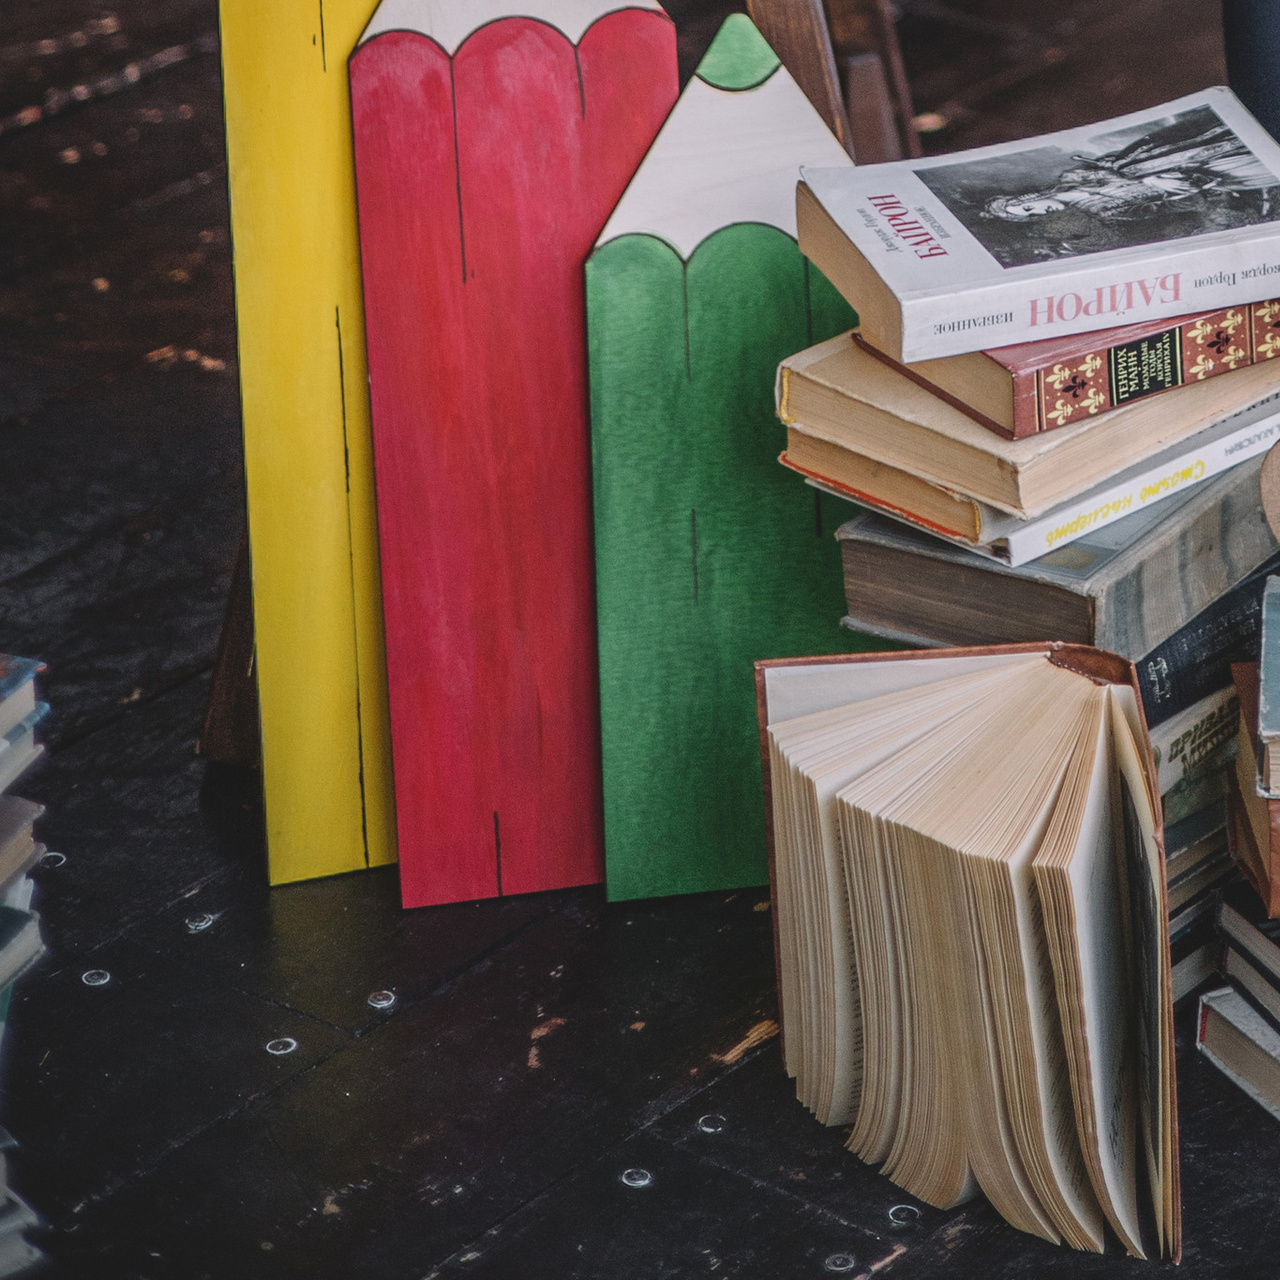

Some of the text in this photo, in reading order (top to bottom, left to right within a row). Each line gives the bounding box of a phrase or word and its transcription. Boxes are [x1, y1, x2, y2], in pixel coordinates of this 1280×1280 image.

[867, 194, 950, 260] БАЙРОН
[1029, 272, 1183, 327] БАЙРОН
[1193, 271, 1237, 289] Гордон
[933, 312, 1014, 336] ИЗБРАННОЕ
[1117, 347, 1129, 400] ГЕНРИХ
[1128, 350, 1140, 392] МАНН
[1141, 340, 1150, 391] МОЛОДЫЕ
[1149, 349, 1157, 378] ГОДЫ
[1155, 341, 1164, 381] КОРОЛЯ
